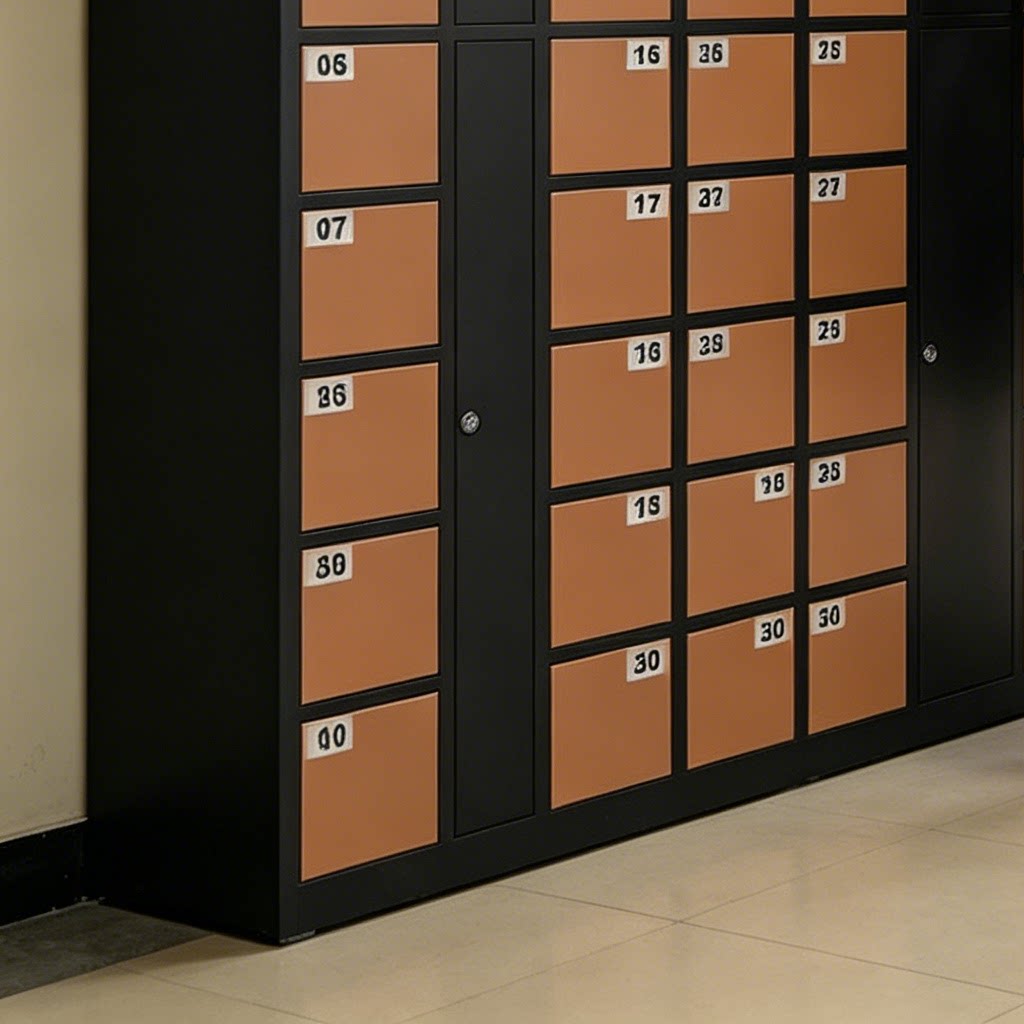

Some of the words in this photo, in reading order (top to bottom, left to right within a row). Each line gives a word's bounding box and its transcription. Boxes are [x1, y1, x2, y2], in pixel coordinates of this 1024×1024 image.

[317, 53, 348, 76] 06
[633, 44, 661, 65] 16
[817, 176, 840, 198] 27
[634, 193, 661, 214] 17
[316, 215, 347, 241] 07
[760, 617, 785, 643] 30
